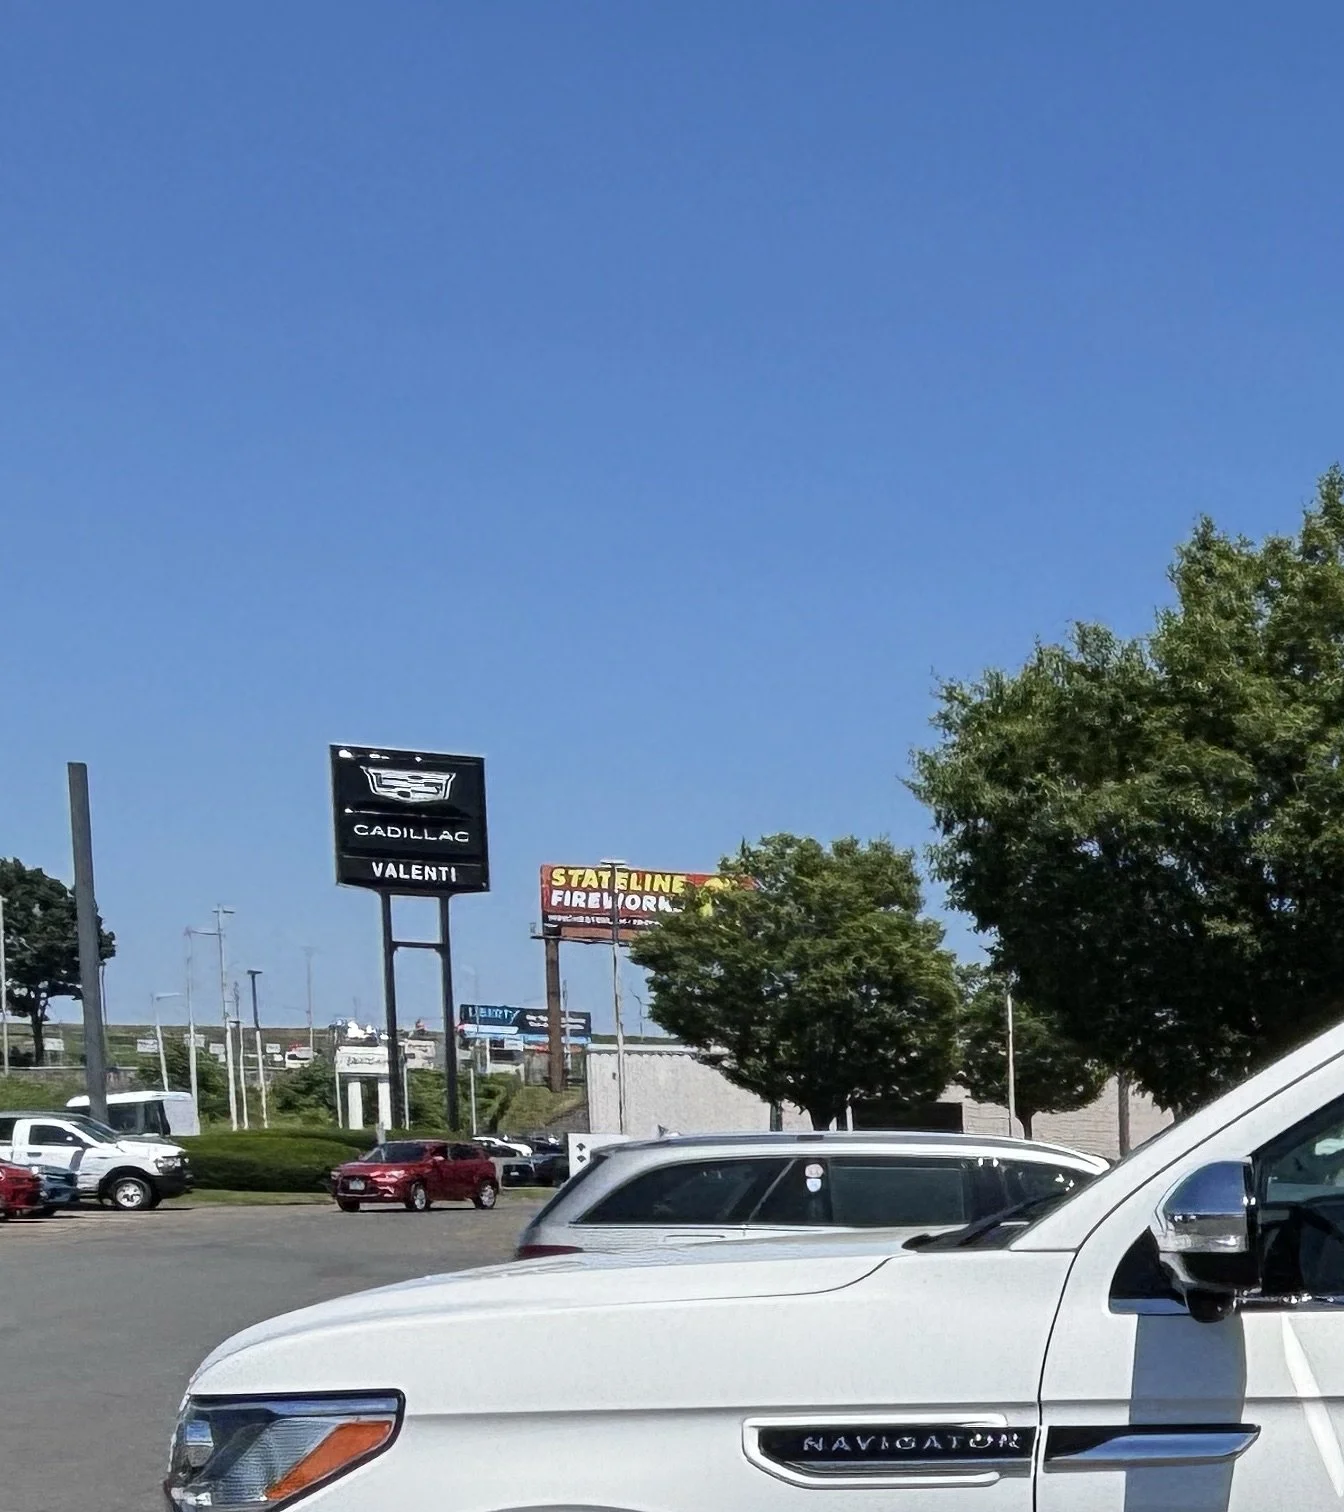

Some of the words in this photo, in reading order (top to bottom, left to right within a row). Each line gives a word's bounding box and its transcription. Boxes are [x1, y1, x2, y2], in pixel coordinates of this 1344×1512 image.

[354, 824, 469, 842] CADILLAC
[372, 861, 457, 882] VALENTI
[551, 867, 686, 894] STATELINE
[550, 889, 684, 913] FIREWORK
[803, 1433, 1020, 1451] NAVIGATOR
